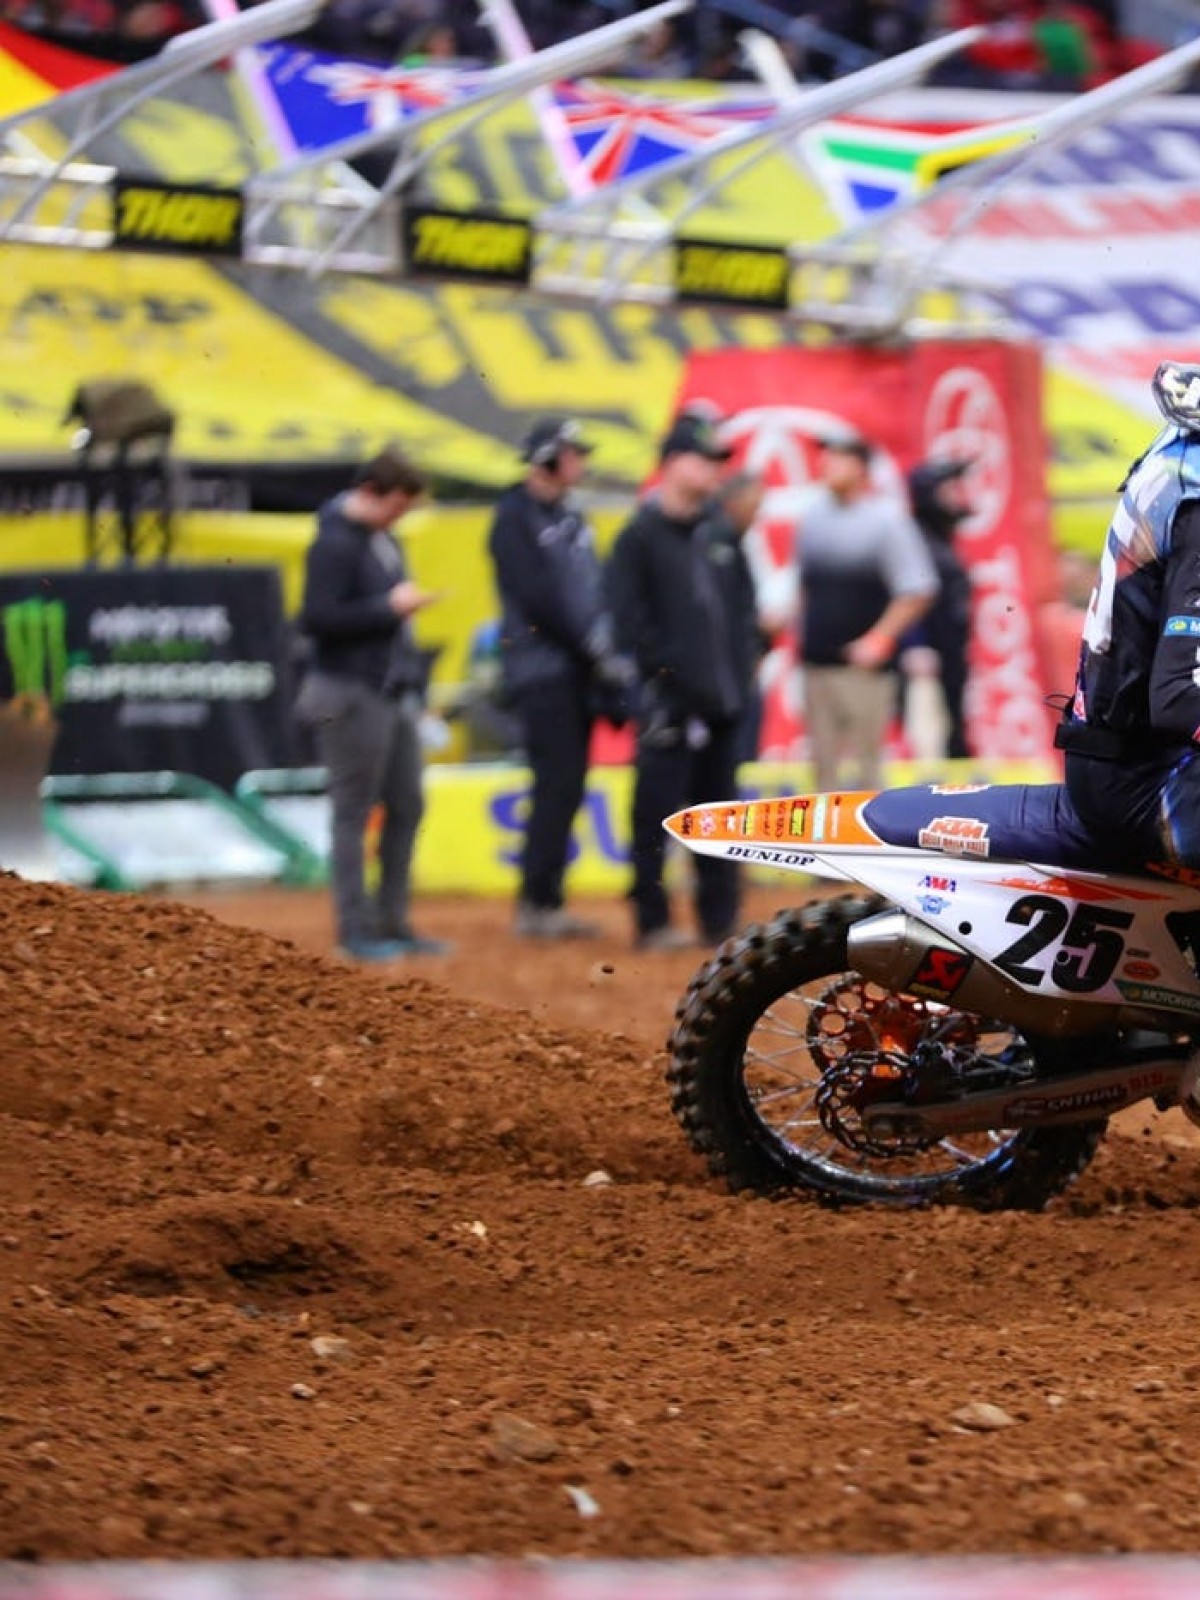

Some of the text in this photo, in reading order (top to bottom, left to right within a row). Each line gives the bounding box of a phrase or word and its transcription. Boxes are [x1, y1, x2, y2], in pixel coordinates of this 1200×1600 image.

[120, 188, 239, 243] THOR
[413, 215, 529, 271] THOR
[726, 846, 815, 868] DUNLOP
[992, 894, 1136, 993] 25
